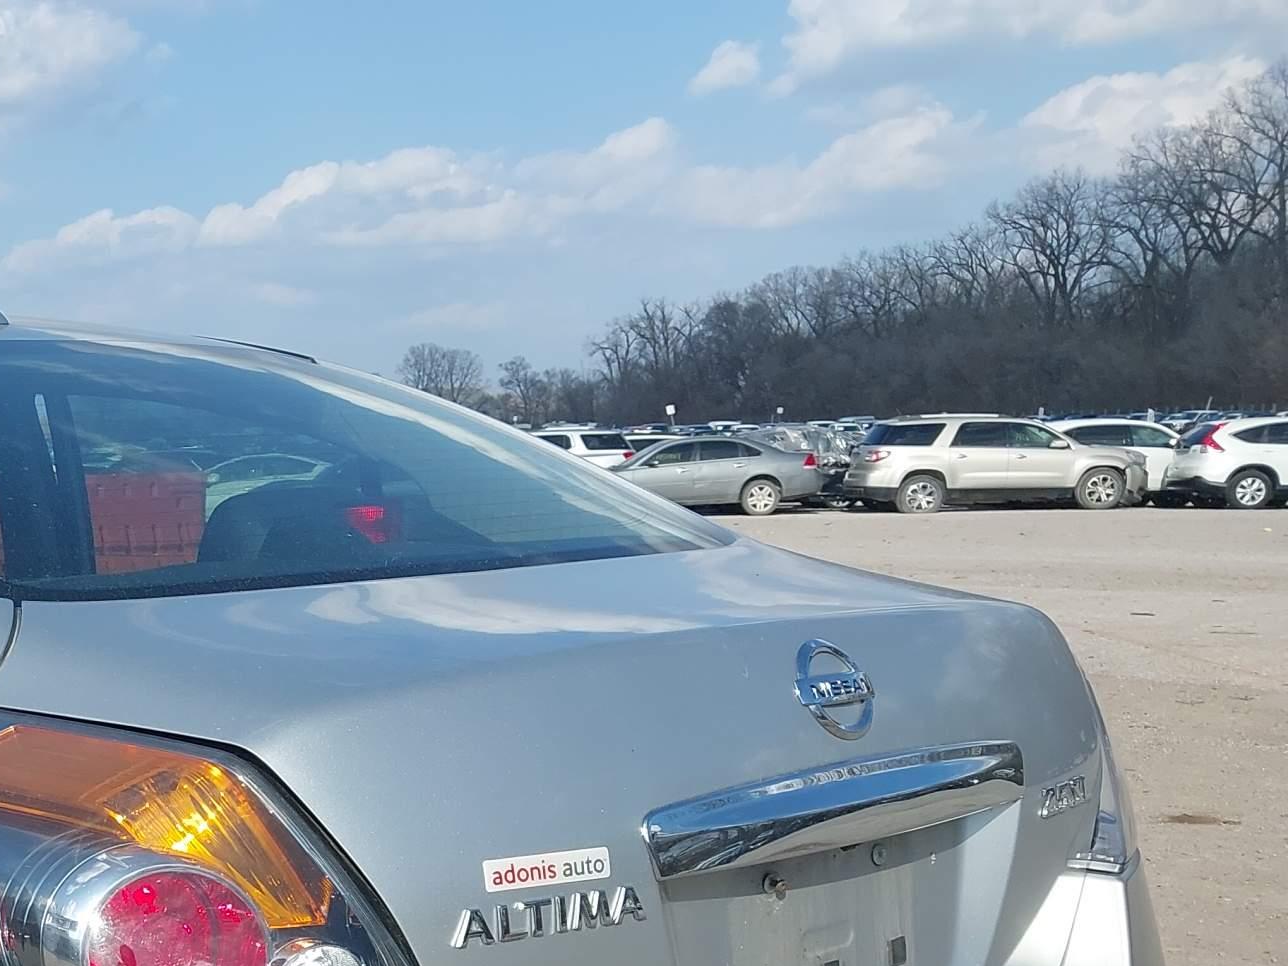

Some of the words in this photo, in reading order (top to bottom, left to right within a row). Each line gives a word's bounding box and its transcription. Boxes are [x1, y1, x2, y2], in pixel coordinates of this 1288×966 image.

[809, 678, 871, 699] NISSAN
[492, 859, 557, 886] adonis
[562, 856, 605, 878] auto
[449, 884, 647, 949] ALTIMA
